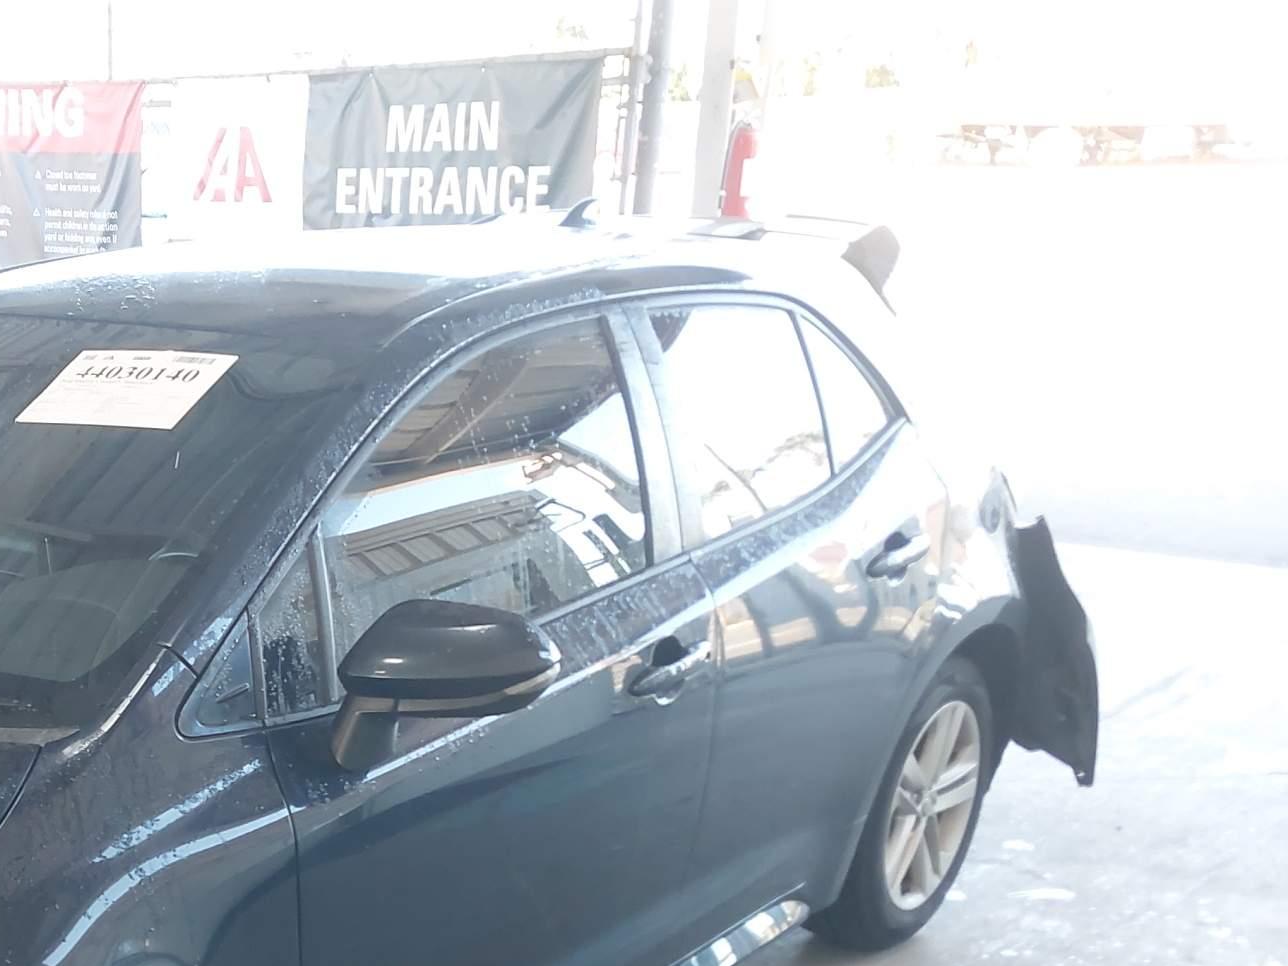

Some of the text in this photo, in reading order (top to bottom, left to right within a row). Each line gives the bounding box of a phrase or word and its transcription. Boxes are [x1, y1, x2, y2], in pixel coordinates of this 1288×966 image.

[385, 101, 500, 153] MAIN
[335, 165, 552, 214] ENTRANCE
[75, 365, 200, 384] 44030140
